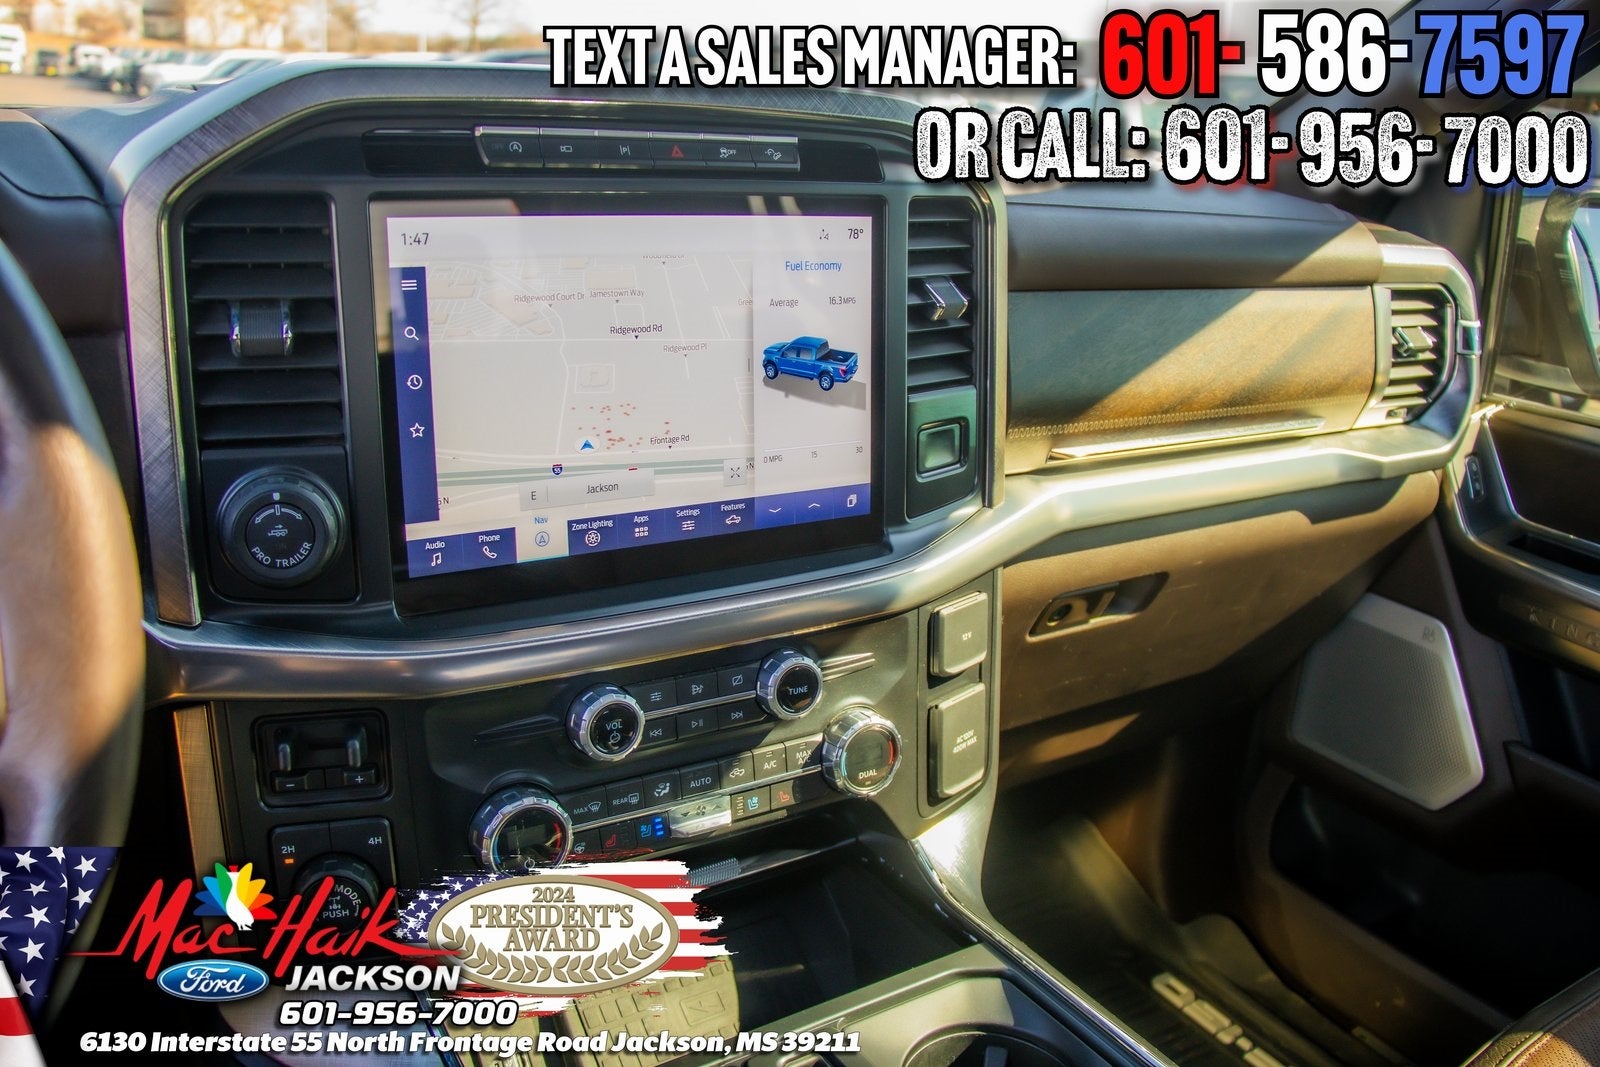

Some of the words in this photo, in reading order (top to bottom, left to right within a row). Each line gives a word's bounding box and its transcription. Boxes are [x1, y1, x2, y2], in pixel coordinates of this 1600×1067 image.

[401, 233, 429, 245] 1:47
[785, 261, 803, 271] Fuel
[804, 261, 842, 272] Economy
[514, 293, 555, 303] Ridgewood
[556, 292, 576, 302] Court
[577, 291, 585, 300] Dr
[589, 289, 629, 298] Jamestown
[630, 288, 645, 298] Way
[769, 298, 799, 309] Average
[610, 325, 651, 336] Ridgewood
[652, 324, 663, 333] Rd
[663, 344, 699, 354] Ridgewood
[650, 436, 680, 446] Frontage
[681, 434, 690, 443] Rd
[811, 450, 818, 459] 15
[855, 446, 863, 454] 30
[769, 454, 783, 464] MPG
[586, 482, 619, 495] Jackson
[531, 490, 537, 500] E
[720, 502, 746, 512] Features
[676, 507, 700, 518] Settings
[534, 516, 549, 525] Nav
[572, 521, 587, 531] Zone
[588, 518, 614, 530] Lighting
[633, 515, 649, 524] Apps
[478, 533, 500, 543] Phone
[425, 540, 445, 550] Audio
[251, 546, 271, 565] PRO
[275, 541, 312, 568] TRAILER
[788, 686, 808, 696] TUNE
[605, 721, 623, 731] VOL
[796, 749, 812, 760] MAX
[762, 759, 777, 770] A/C
[858, 768, 878, 779] DUAL
[690, 777, 712, 789] AUTO
[612, 797, 629, 806] REAR
[573, 806, 589, 815] MAX
[368, 836, 382, 846] 4H
[281, 845, 295, 854] 2H
[334, 884, 362, 905] MODE
[322, 910, 350, 919] PUSH
